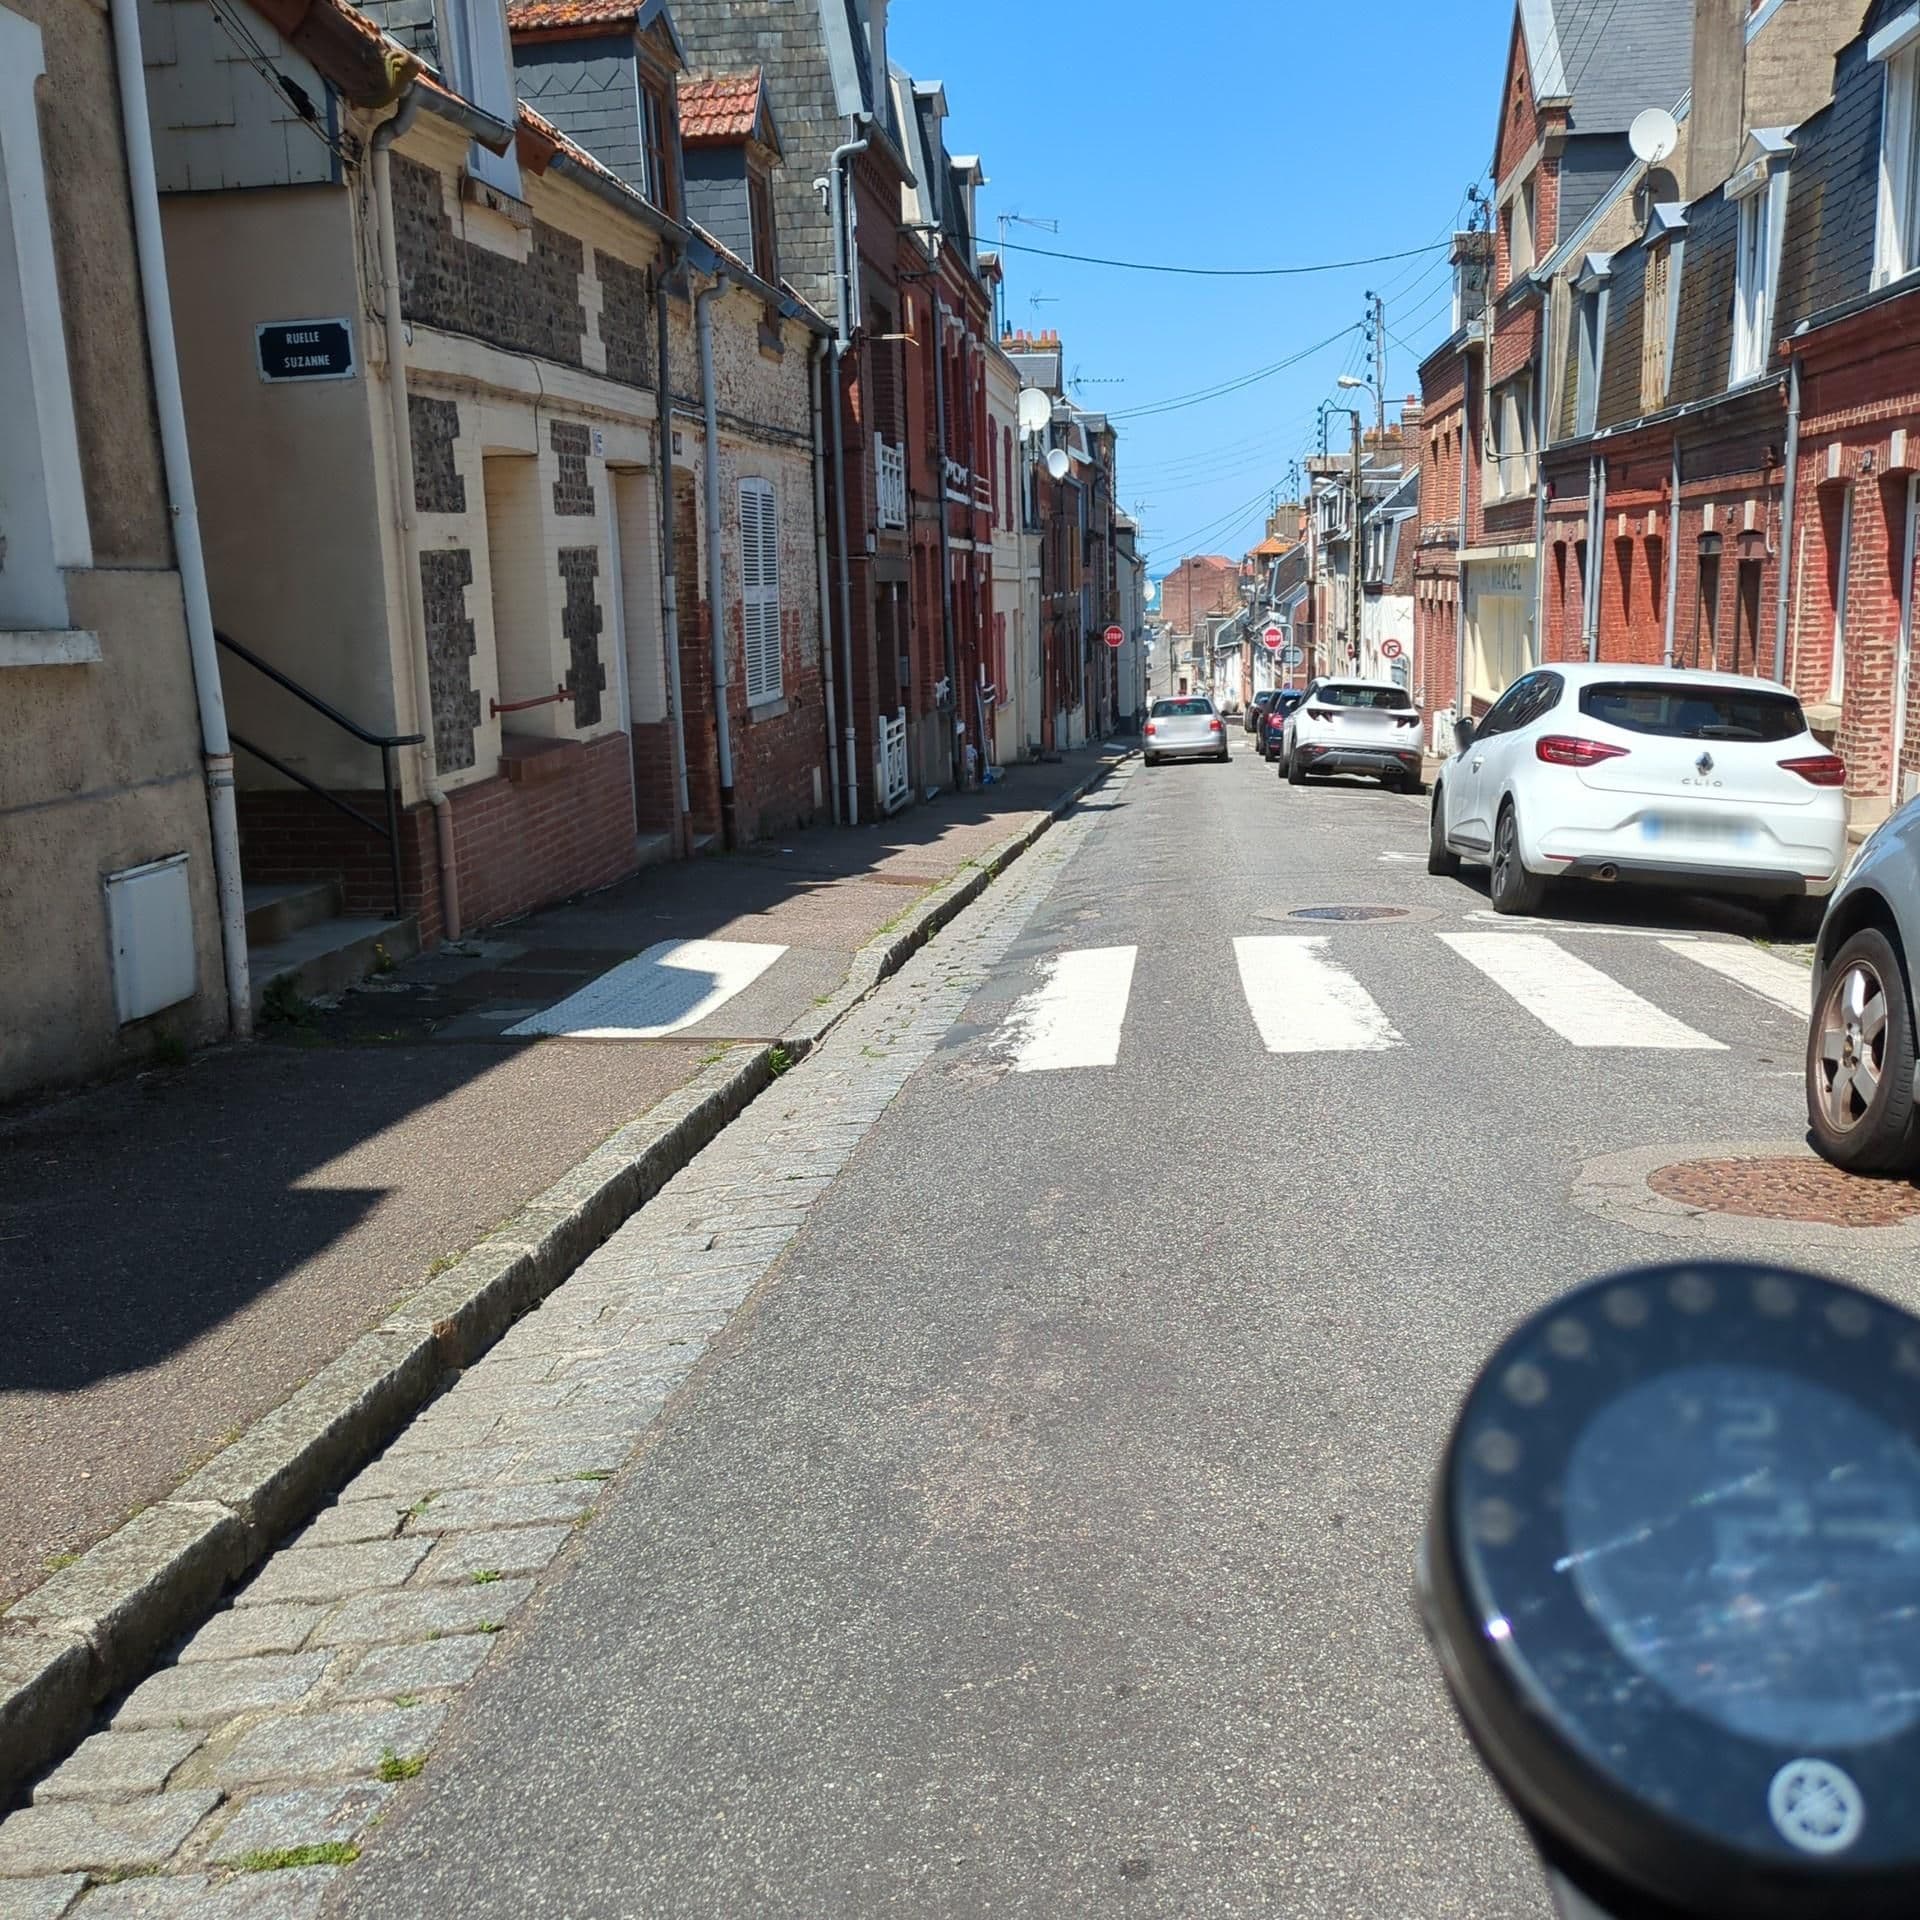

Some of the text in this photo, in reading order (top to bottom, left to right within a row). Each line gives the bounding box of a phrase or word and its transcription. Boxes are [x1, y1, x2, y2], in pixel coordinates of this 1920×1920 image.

[285, 331, 320, 344] RUELLE
[284, 354, 331, 368] SUZANNE
[1107, 632, 1121, 640] STOP
[1265, 634, 1280, 642] STOP
[1681, 777, 1723, 788] CLIO
